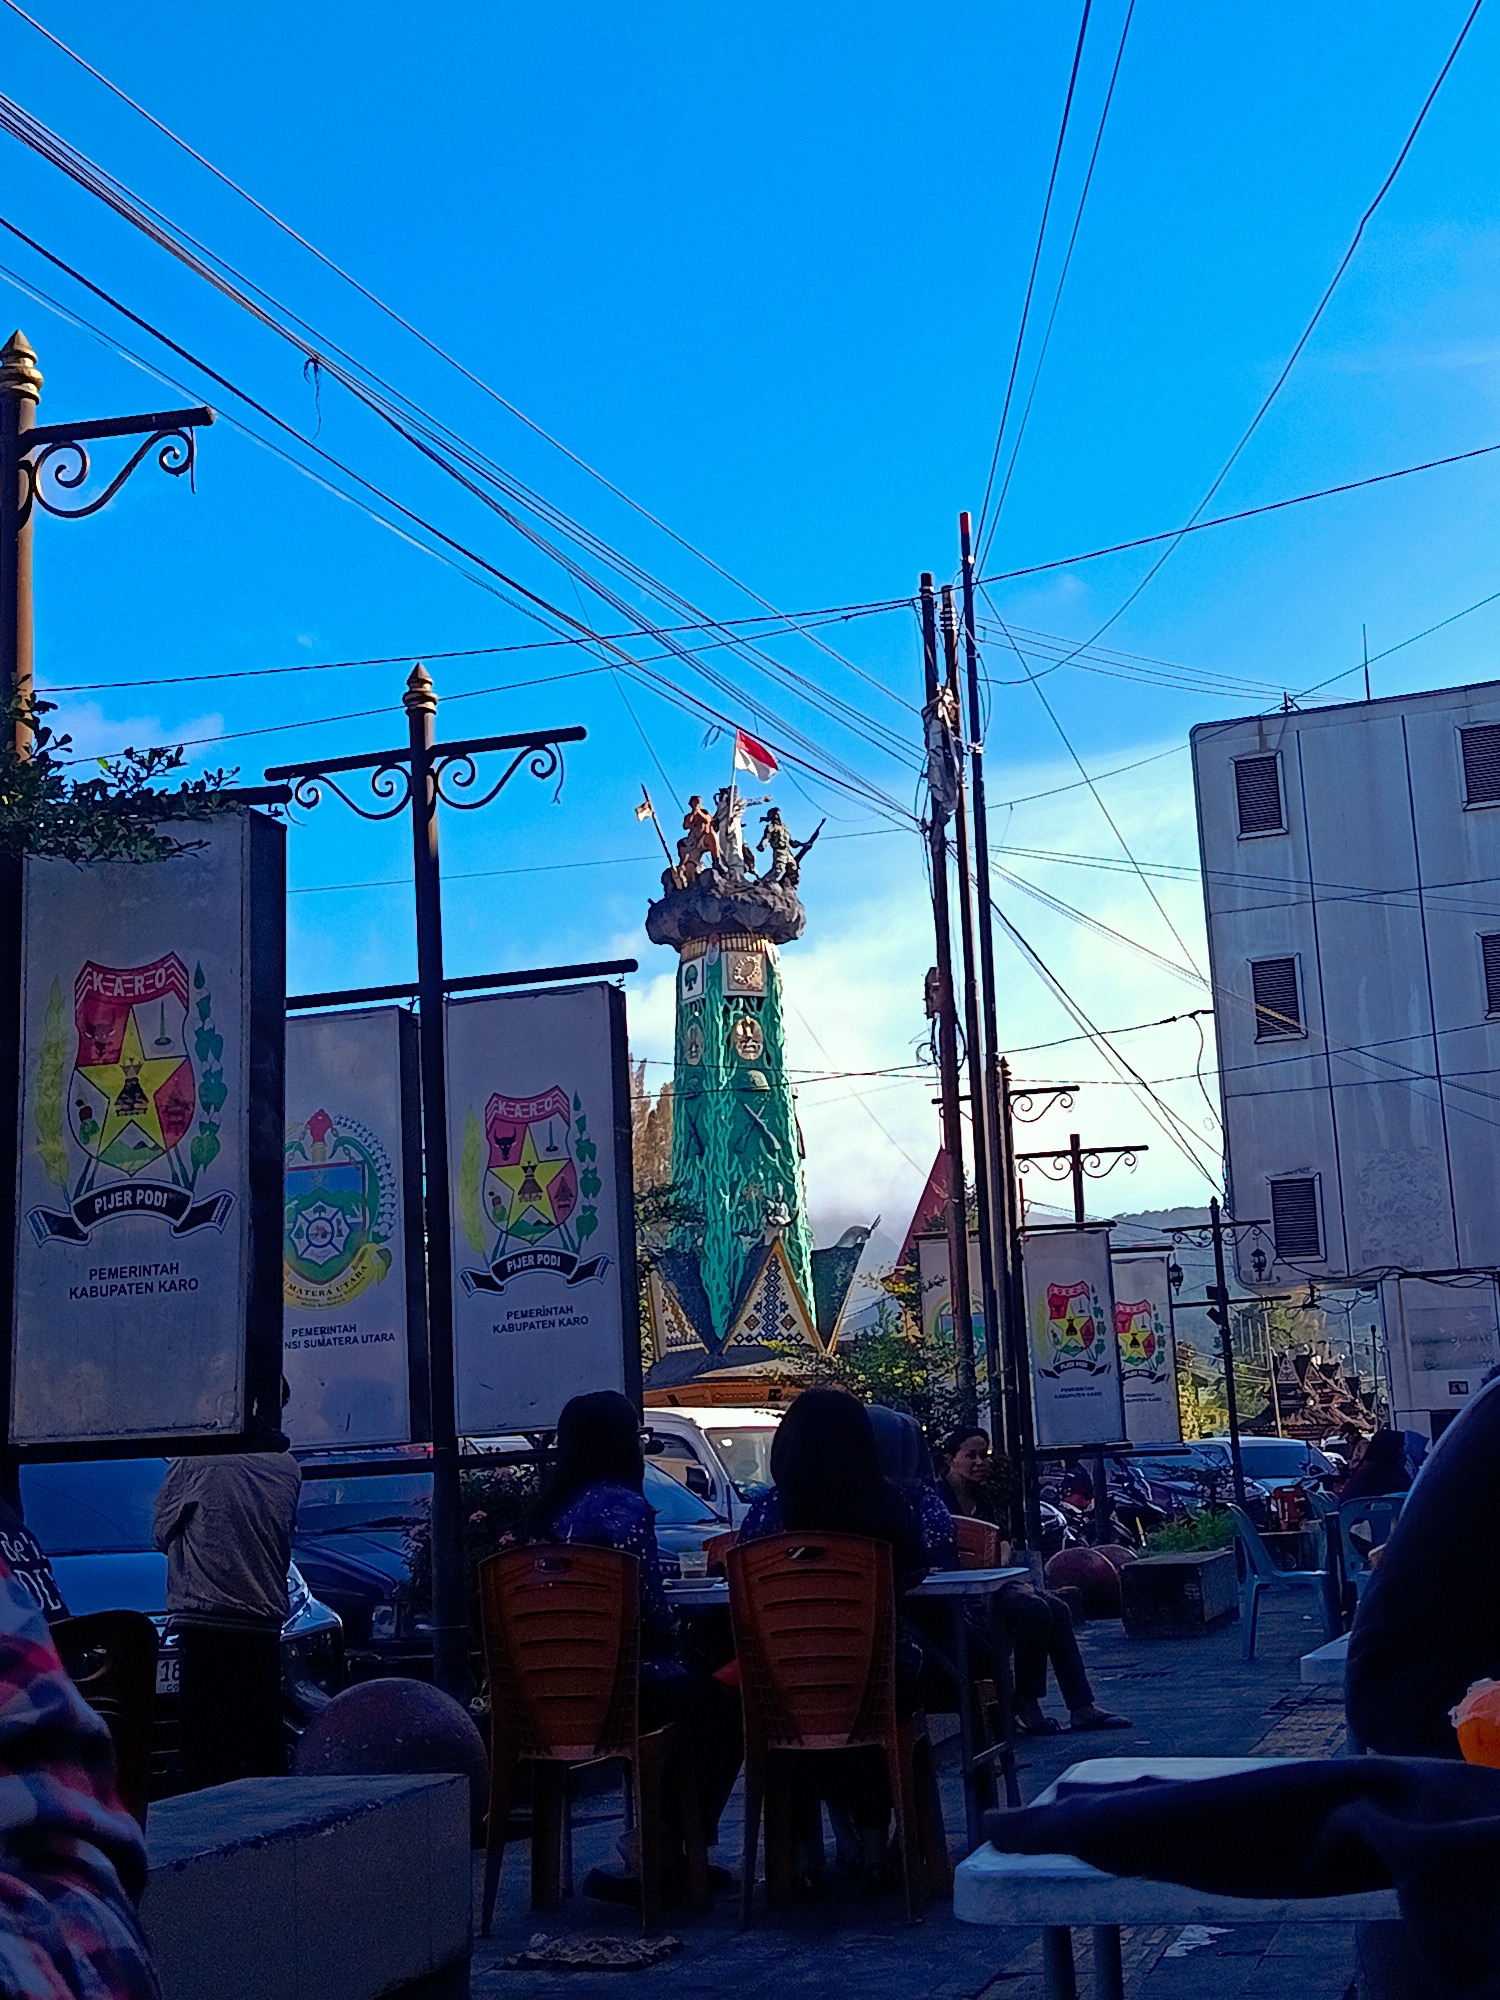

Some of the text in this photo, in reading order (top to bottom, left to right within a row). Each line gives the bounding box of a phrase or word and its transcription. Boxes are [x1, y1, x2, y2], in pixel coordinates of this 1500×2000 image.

[92, 967, 167, 998] KARO
[498, 1097, 554, 1119] KARO
[94, 1189, 168, 1214] PIJER PODI
[89, 1262, 180, 1281] PEMERINTAH
[506, 1254, 561, 1273] PIJER PODI
[69, 1277, 199, 1300] KABUPATEN KARO
[506, 1305, 574, 1321] PEMERINTAH
[291, 1324, 357, 1338] PEMERINTAH
[492, 1315, 589, 1334] KABUPATEN KARO
[303, 1336, 359, 1349] SUMATERA
[361, 1332, 396, 1344] UTARA
